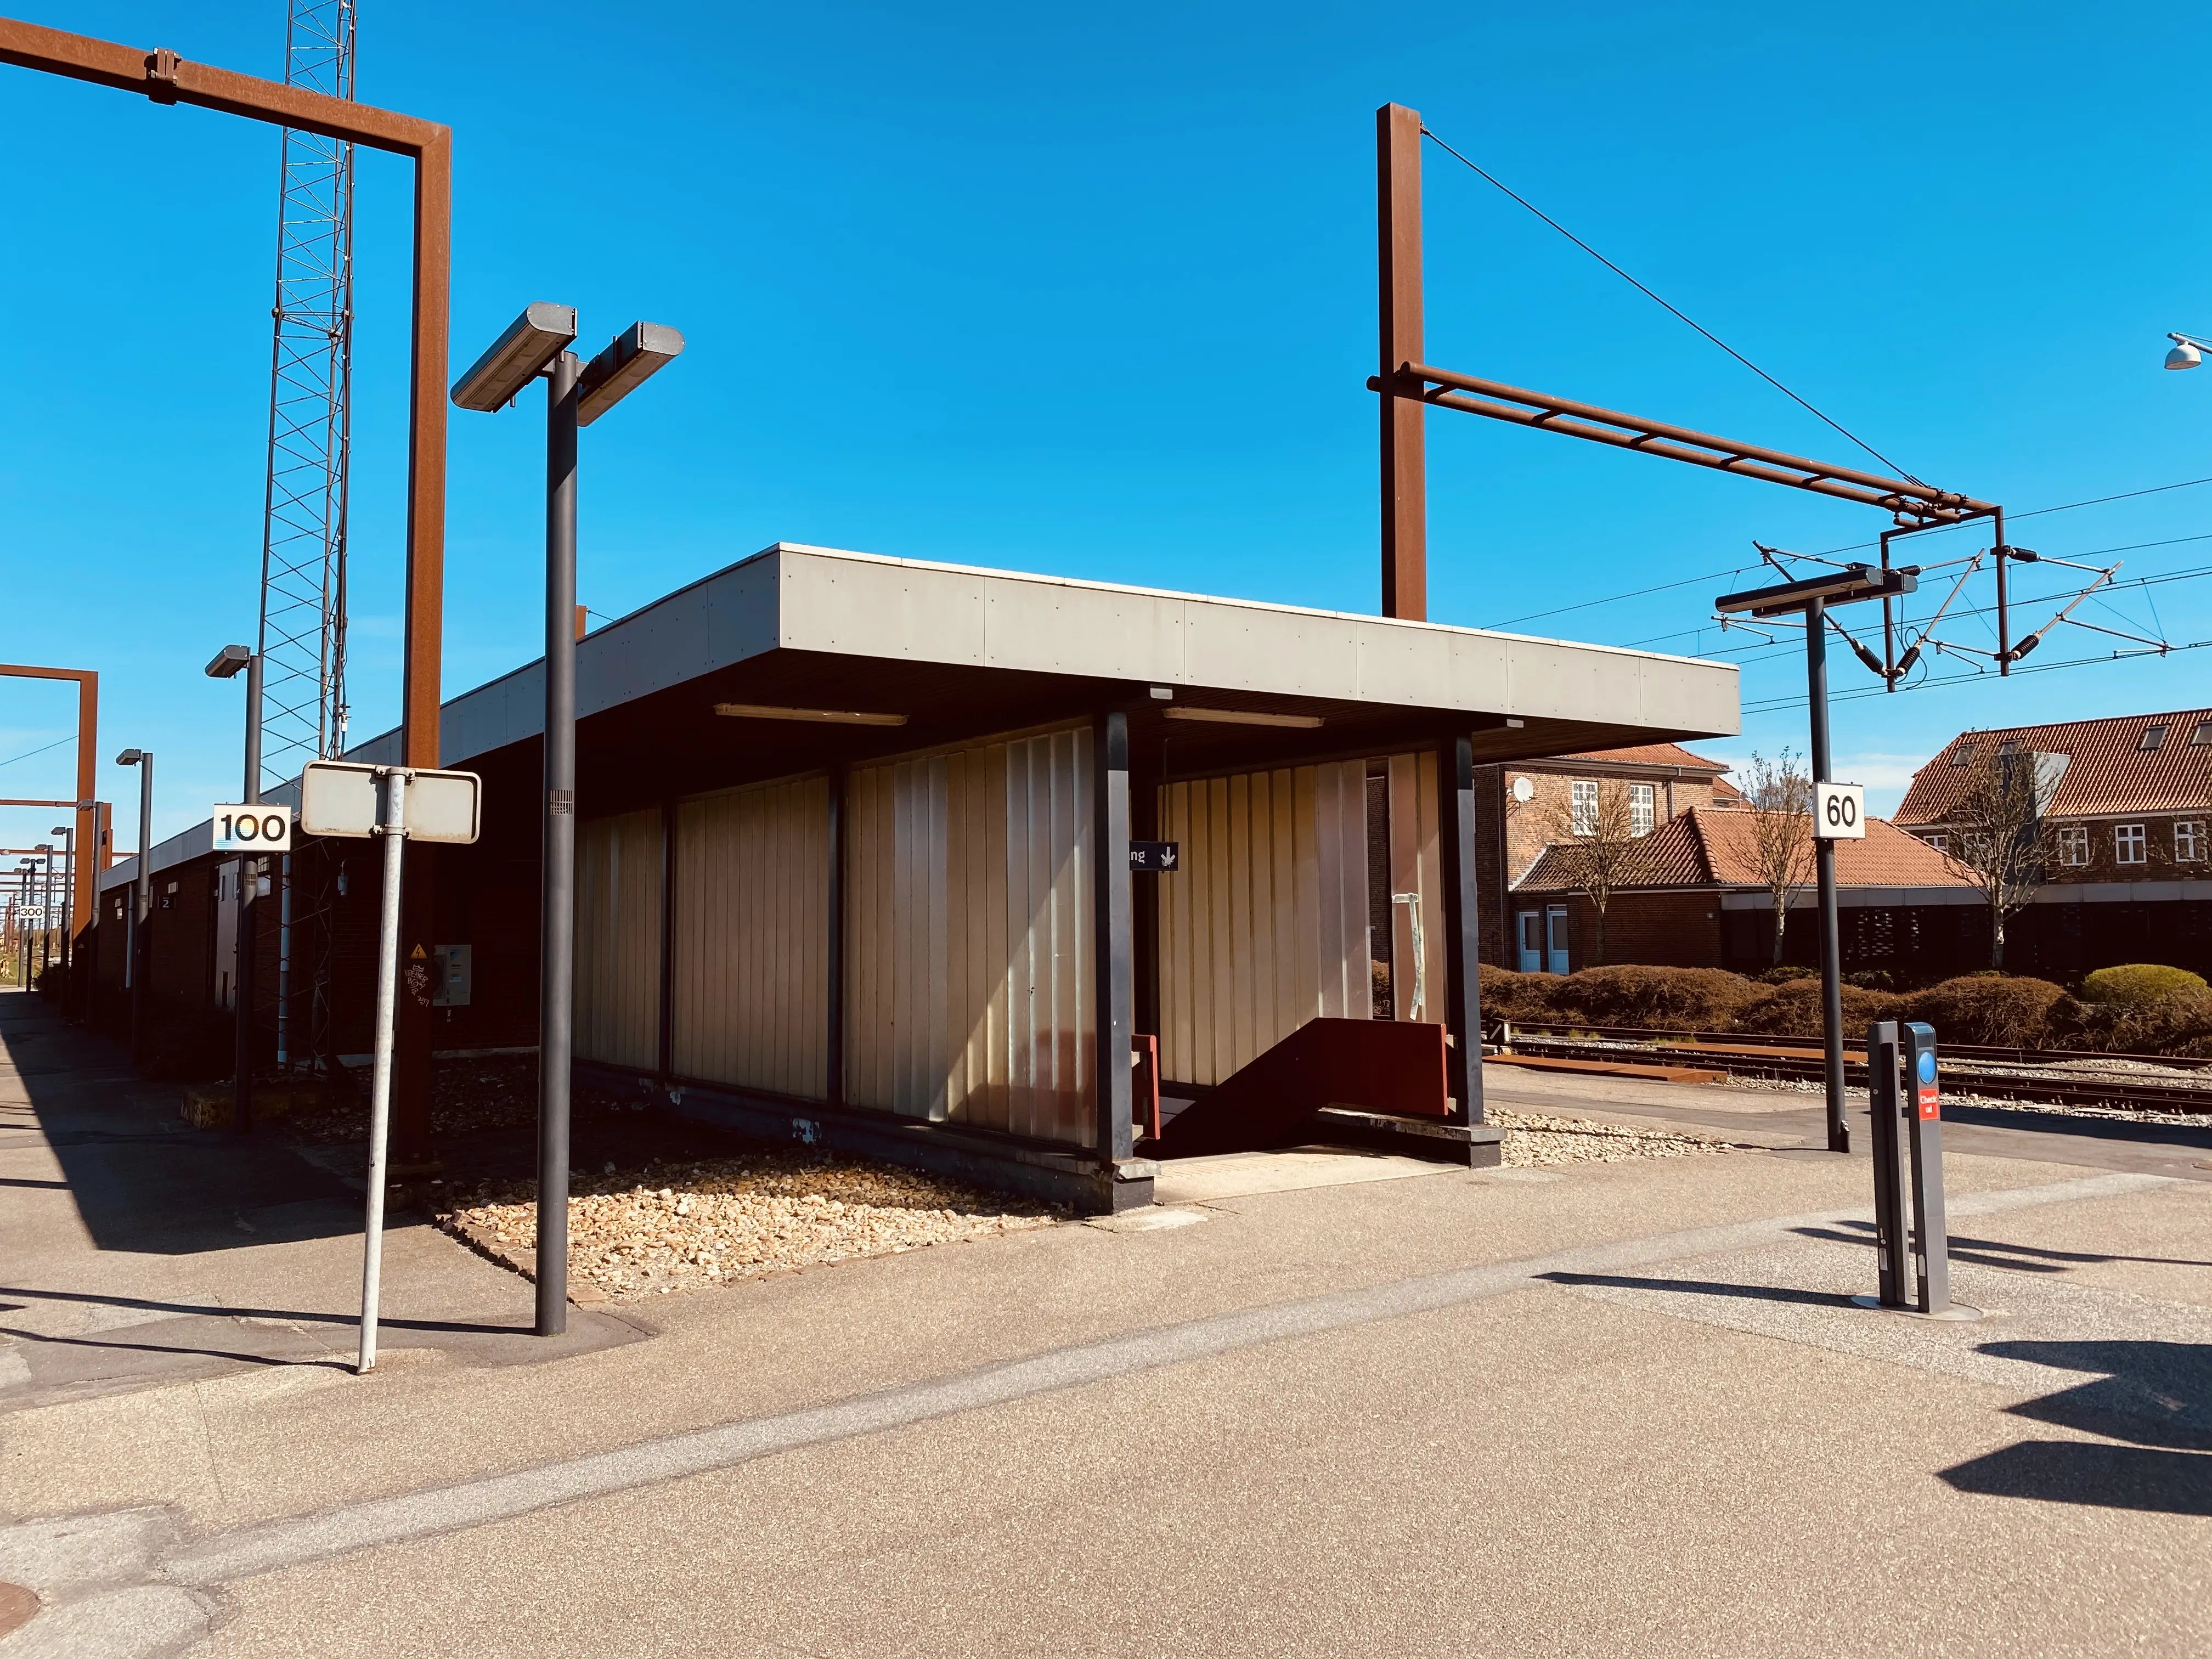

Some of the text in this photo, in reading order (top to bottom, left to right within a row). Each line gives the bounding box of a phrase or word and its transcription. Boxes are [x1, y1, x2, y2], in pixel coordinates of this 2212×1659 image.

[1827, 794, 1856, 827] 60
[221, 814, 285, 842] 100
[20, 908, 43, 916] 300
[1920, 1095, 1938, 1104] Check
